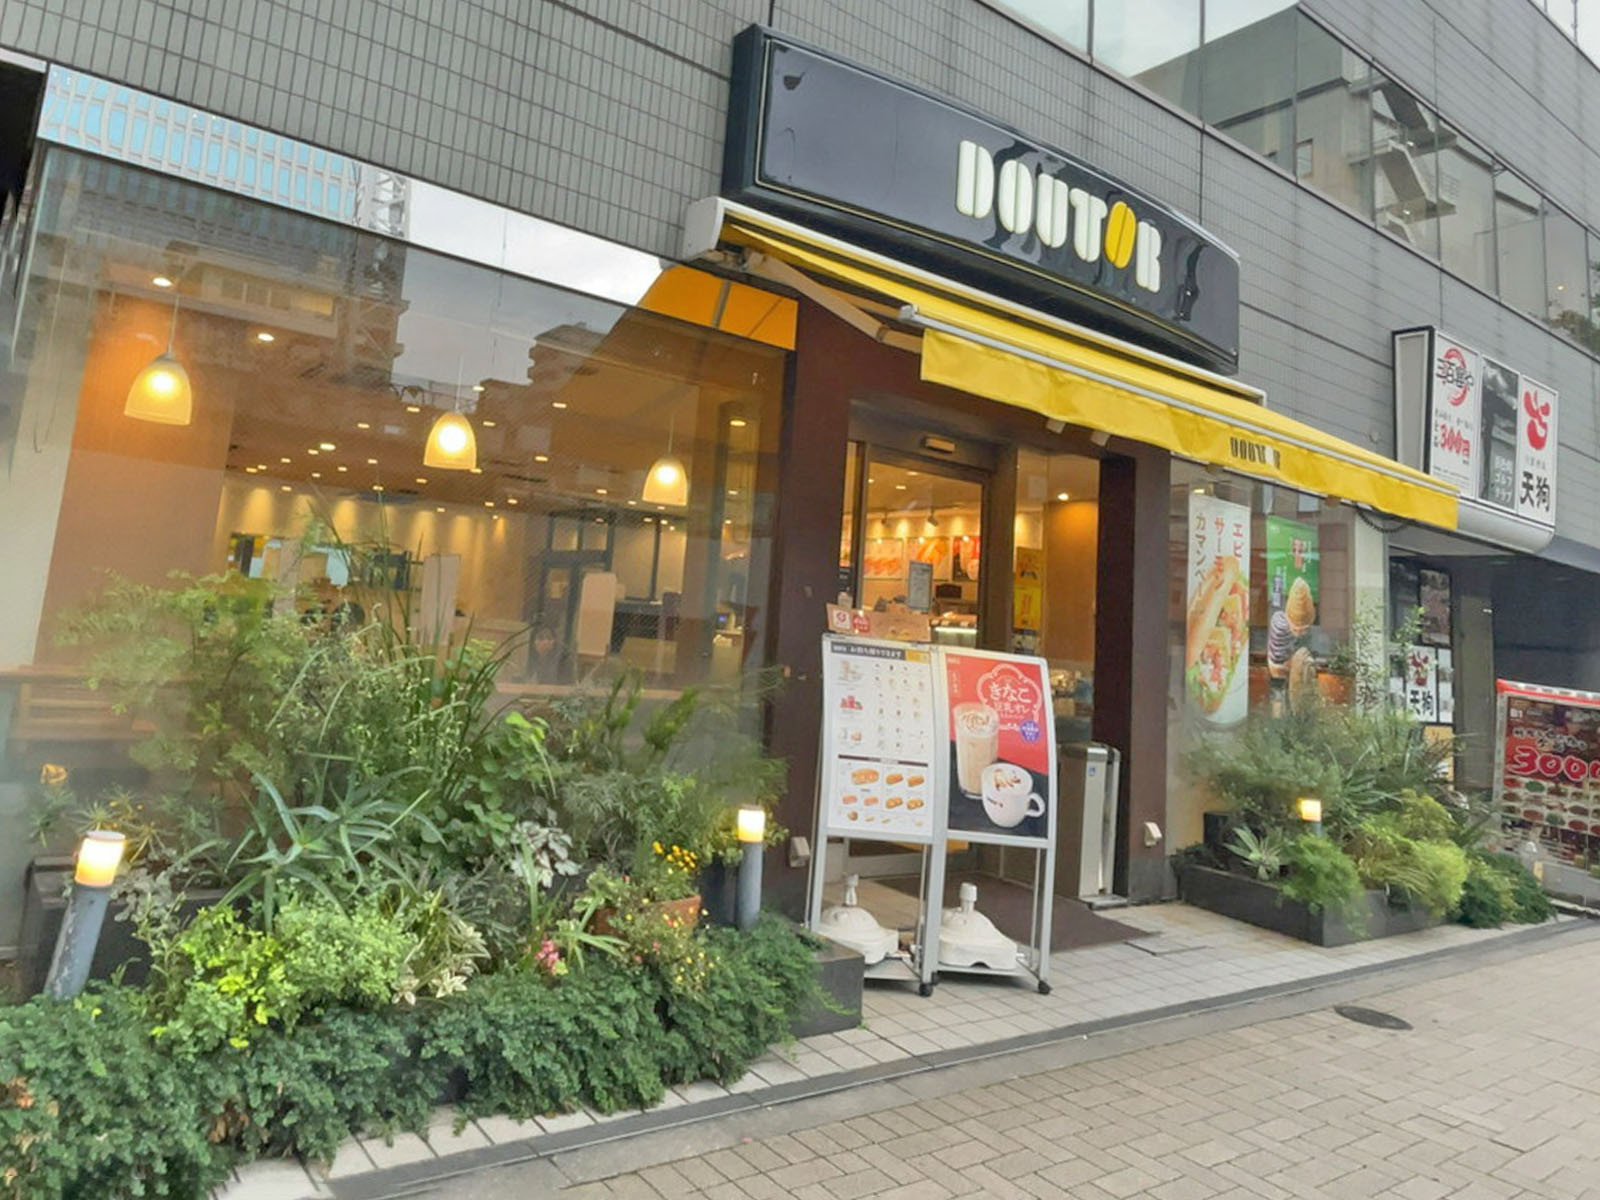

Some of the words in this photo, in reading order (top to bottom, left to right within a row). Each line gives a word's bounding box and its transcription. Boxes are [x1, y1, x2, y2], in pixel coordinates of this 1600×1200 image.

[955, 139, 1163, 294] DOUTOR
[1519, 470, 1550, 512] 天狗
[1232, 522, 1244, 558] エビ
[989, 681, 1032, 703] きなこ
[1409, 689, 1434, 717] 天狗
